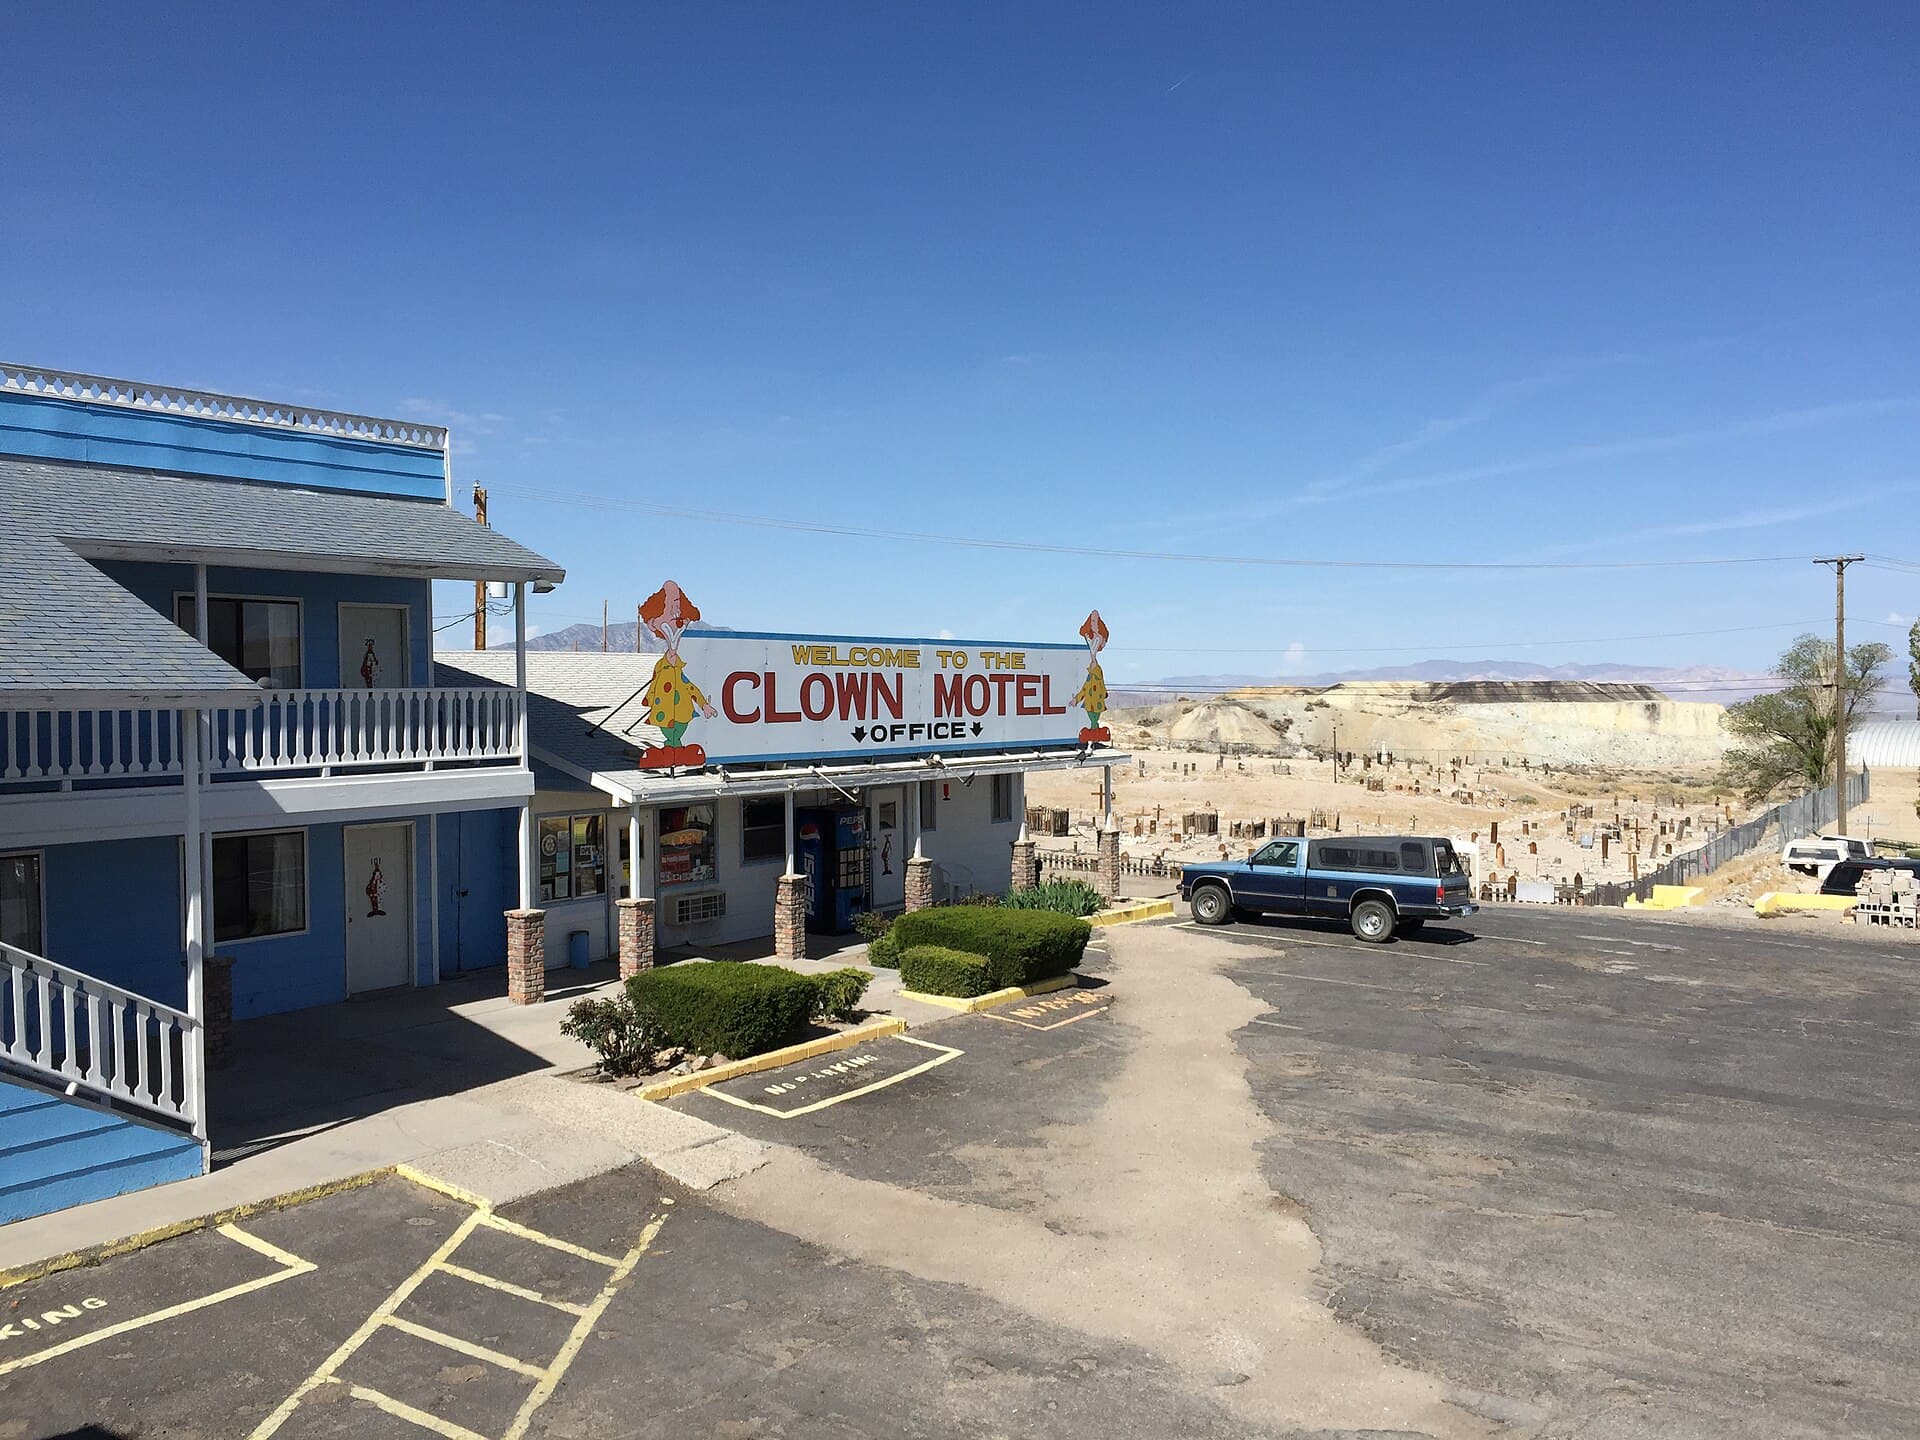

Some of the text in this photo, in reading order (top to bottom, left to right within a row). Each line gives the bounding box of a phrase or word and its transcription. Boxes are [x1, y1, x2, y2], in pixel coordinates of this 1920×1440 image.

[792, 645, 1026, 670] WELCOME TO THE
[722, 671, 1066, 724] CLOWN MOTEL
[870, 722, 966, 743] OFFICE
[370, 857, 381, 865] 101
[804, 852, 815, 916] PEPSI
[764, 1054, 878, 1095] NO PARKING
